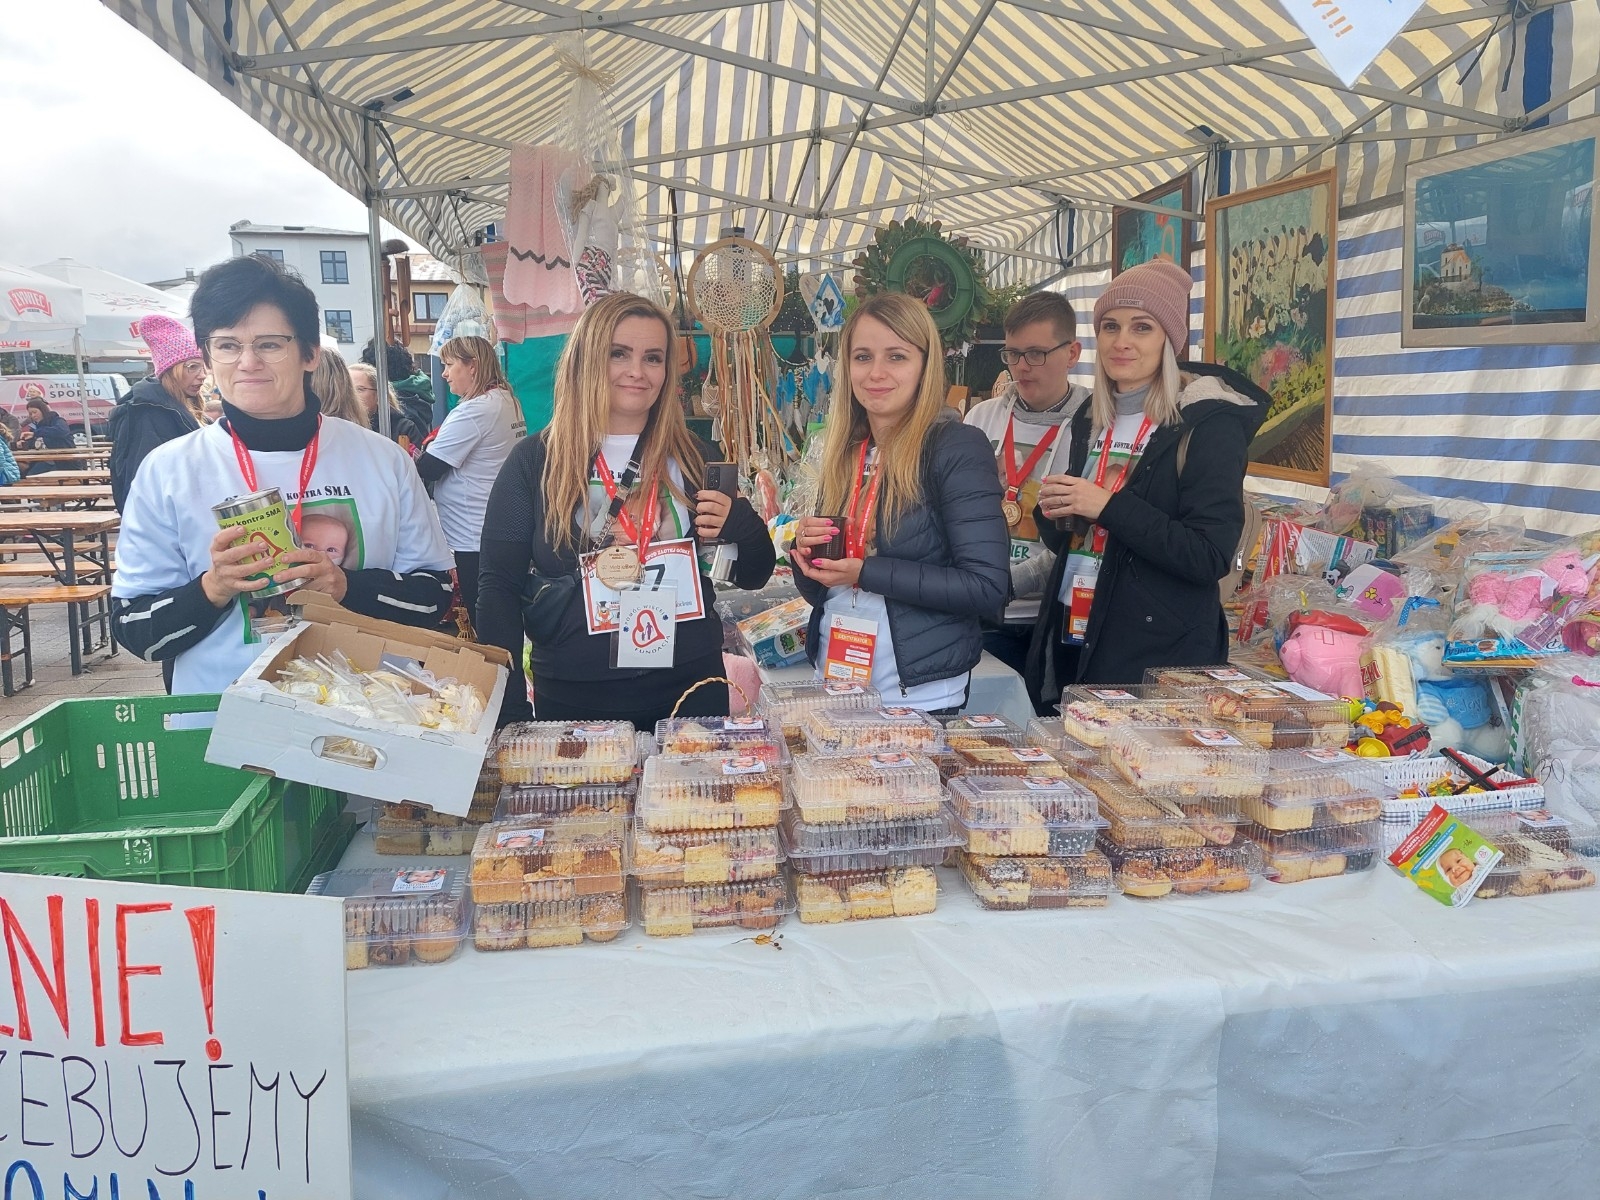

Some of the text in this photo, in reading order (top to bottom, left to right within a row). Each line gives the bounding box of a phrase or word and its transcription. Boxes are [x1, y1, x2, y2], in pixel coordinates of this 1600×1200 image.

[324, 485, 352, 496] SMA
[236, 514, 265, 526] kontra
[265, 507, 281, 518] SMA
[0, 894, 222, 1061] NIE!
